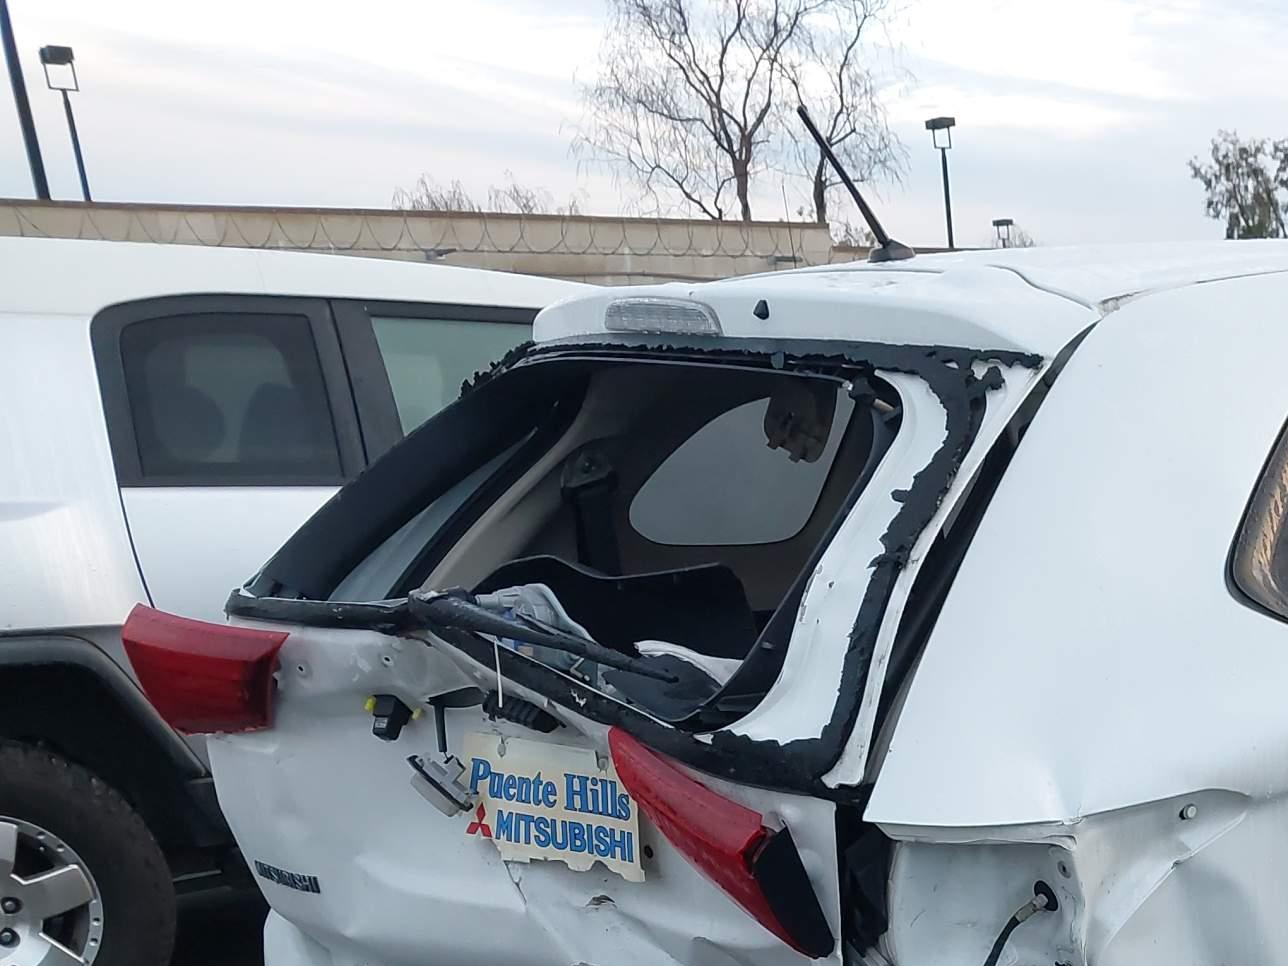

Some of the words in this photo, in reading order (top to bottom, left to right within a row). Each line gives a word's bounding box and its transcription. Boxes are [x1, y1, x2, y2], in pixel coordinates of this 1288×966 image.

[471, 758, 557, 808] Puente
[564, 773, 631, 821] Hills
[495, 810, 634, 863] MITSUBISHI
